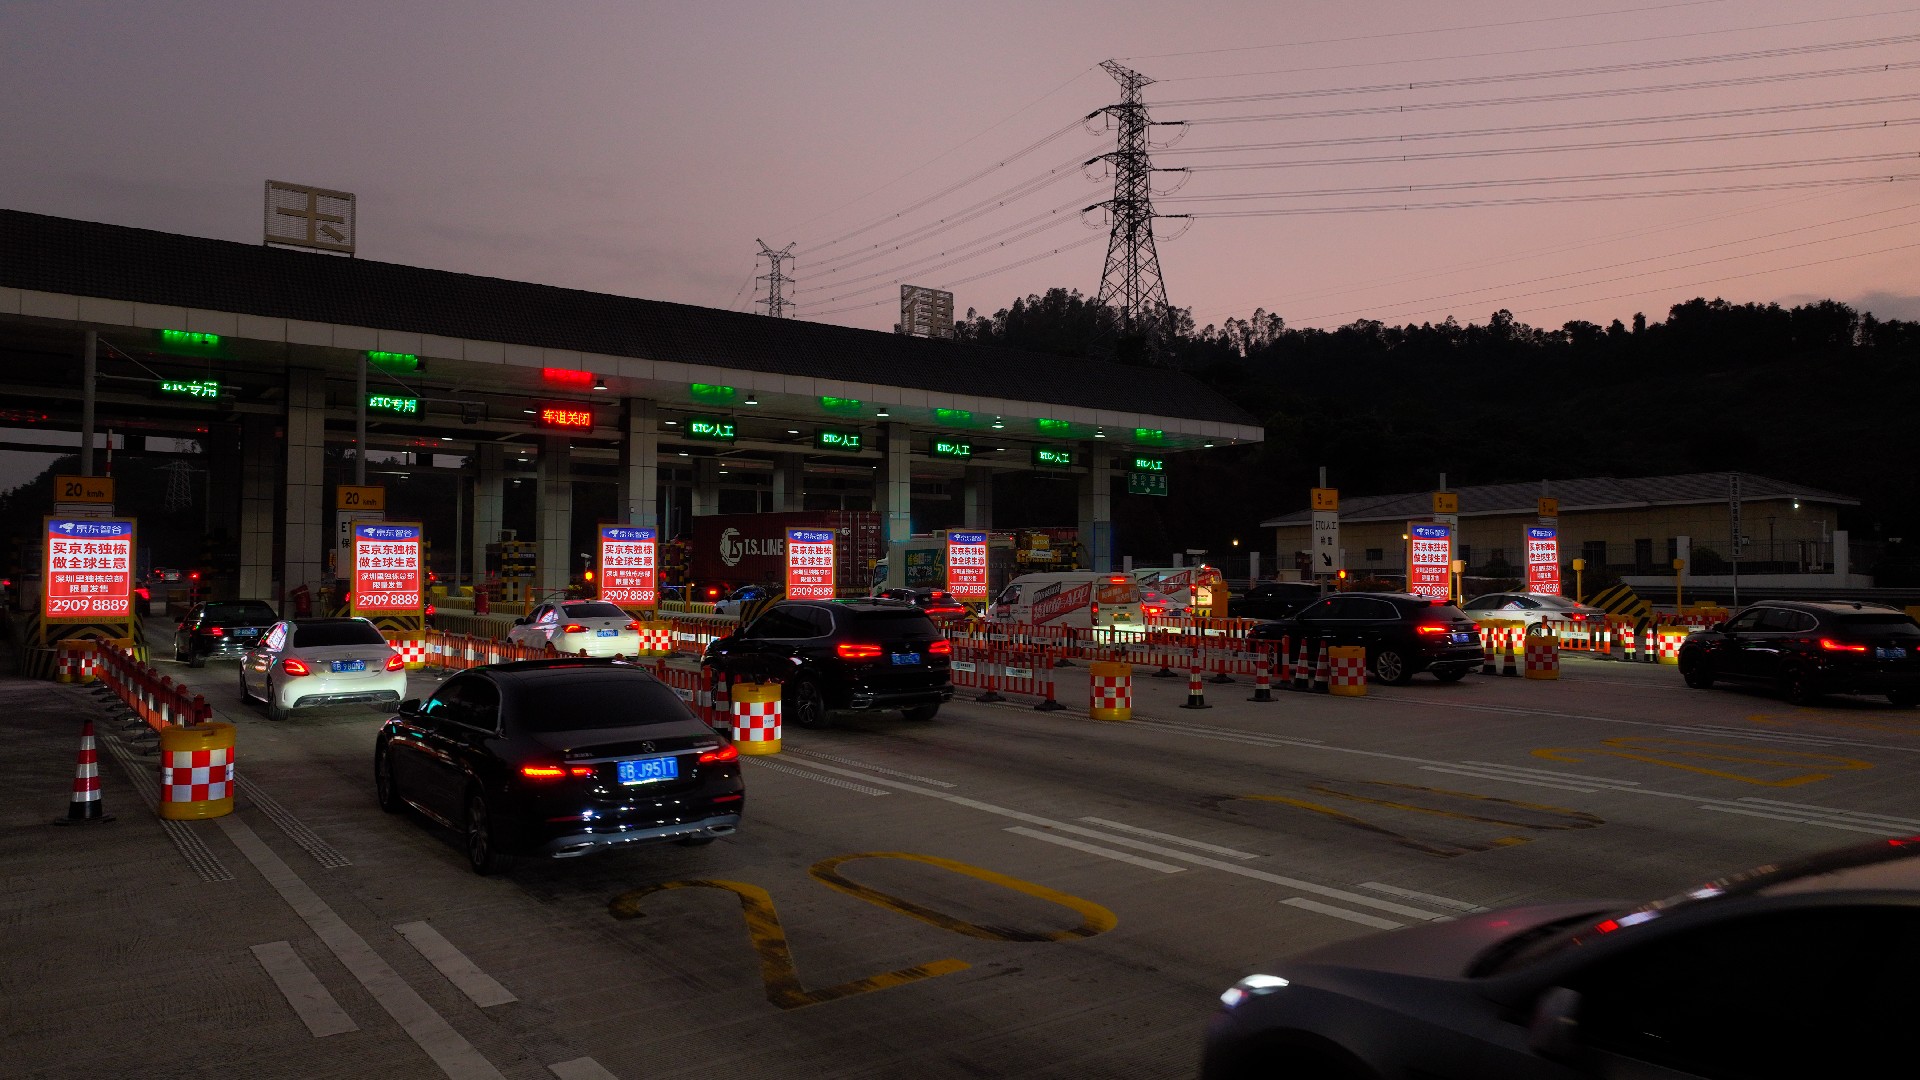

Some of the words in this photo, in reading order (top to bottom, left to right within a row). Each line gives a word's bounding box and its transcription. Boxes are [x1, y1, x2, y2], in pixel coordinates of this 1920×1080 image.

[543, 410, 591, 426] 车道关闭
[692, 423, 734, 437] ETC/人工
[823, 434, 860, 447] ETC/人工
[938, 443, 971, 455] ETC/人工
[65, 483, 82, 497] 20
[345, 492, 360, 505] 20
[77, 525, 122, 534] 京东智谷
[376, 529, 412, 538] 京东智谷
[53, 542, 128, 555] 买京东独栋
[359, 545, 417, 555] 买京东独栋
[605, 545, 653, 555] 买京东独栋
[762, 539, 786, 556] LINE
[52, 557, 127, 570] 做全球生意
[359, 557, 417, 568] 做全球生意
[605, 556, 653, 566] 做全球生意
[55, 574, 124, 583] 深圳里独栋总部
[69, 585, 109, 594] 限量发售
[791, 587, 812, 596] 2909
[813, 587, 834, 596] 8889
[951, 585, 968, 594] 2909
[359, 595, 388, 606] 2909
[391, 594, 420, 605] 8889
[604, 590, 628, 601] 2909
[630, 590, 654, 600] 8889
[51, 599, 89, 612] 2909
[92, 599, 129, 611] 8889
